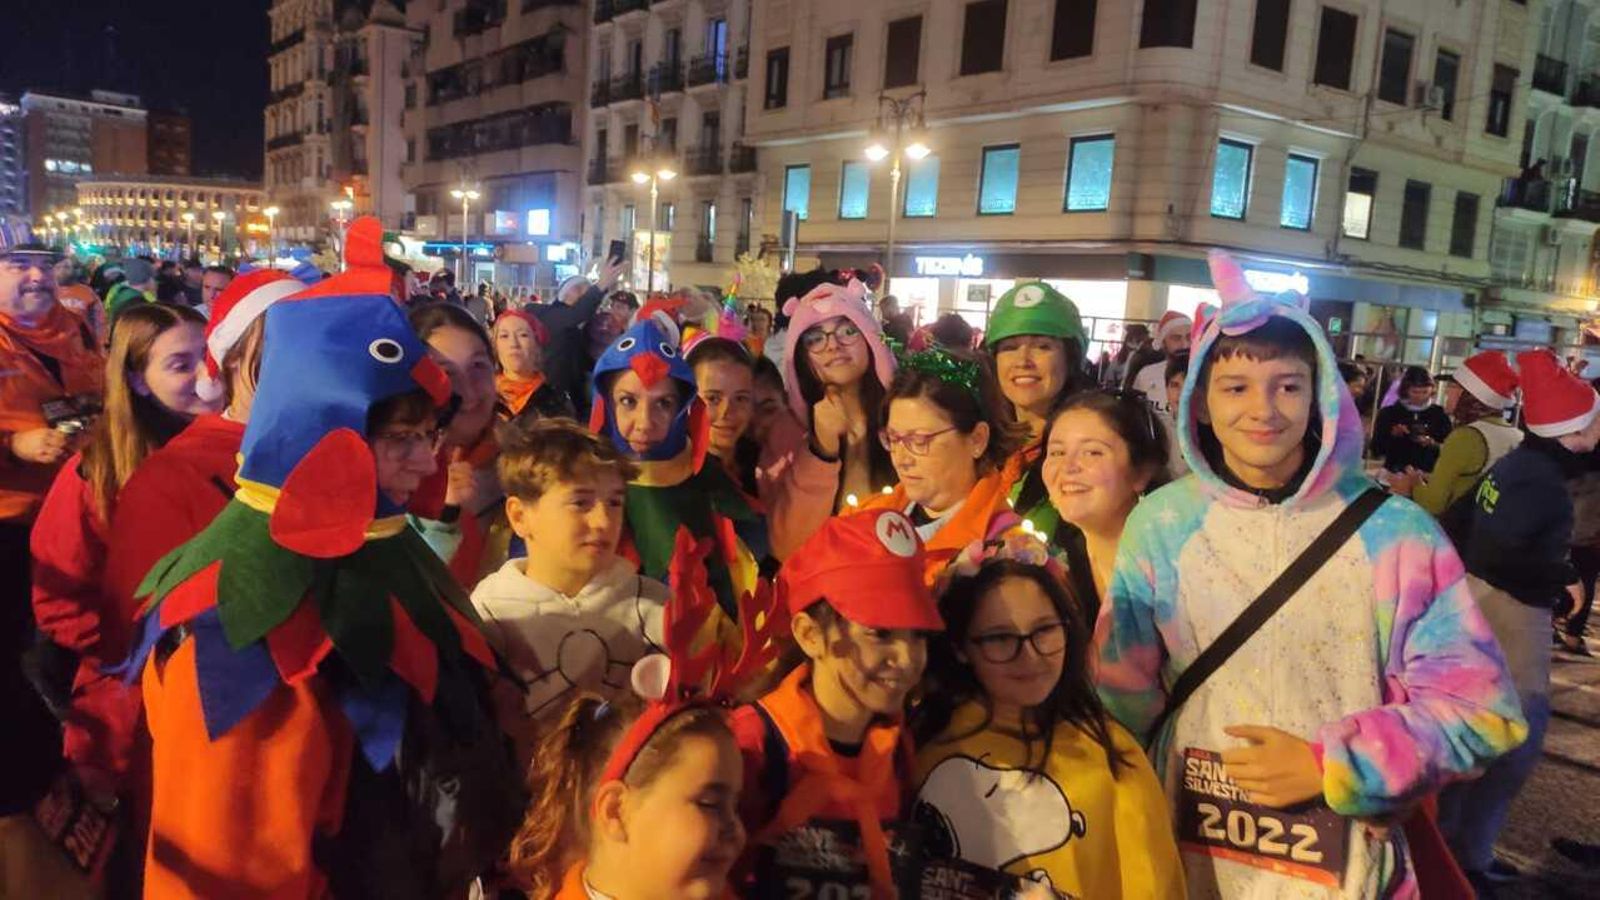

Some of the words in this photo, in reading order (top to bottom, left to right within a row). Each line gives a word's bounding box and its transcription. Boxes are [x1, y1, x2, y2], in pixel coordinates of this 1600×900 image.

[885, 518, 910, 540] M
[1185, 757, 1234, 785] SAN
[1197, 802, 1323, 864] 2022
